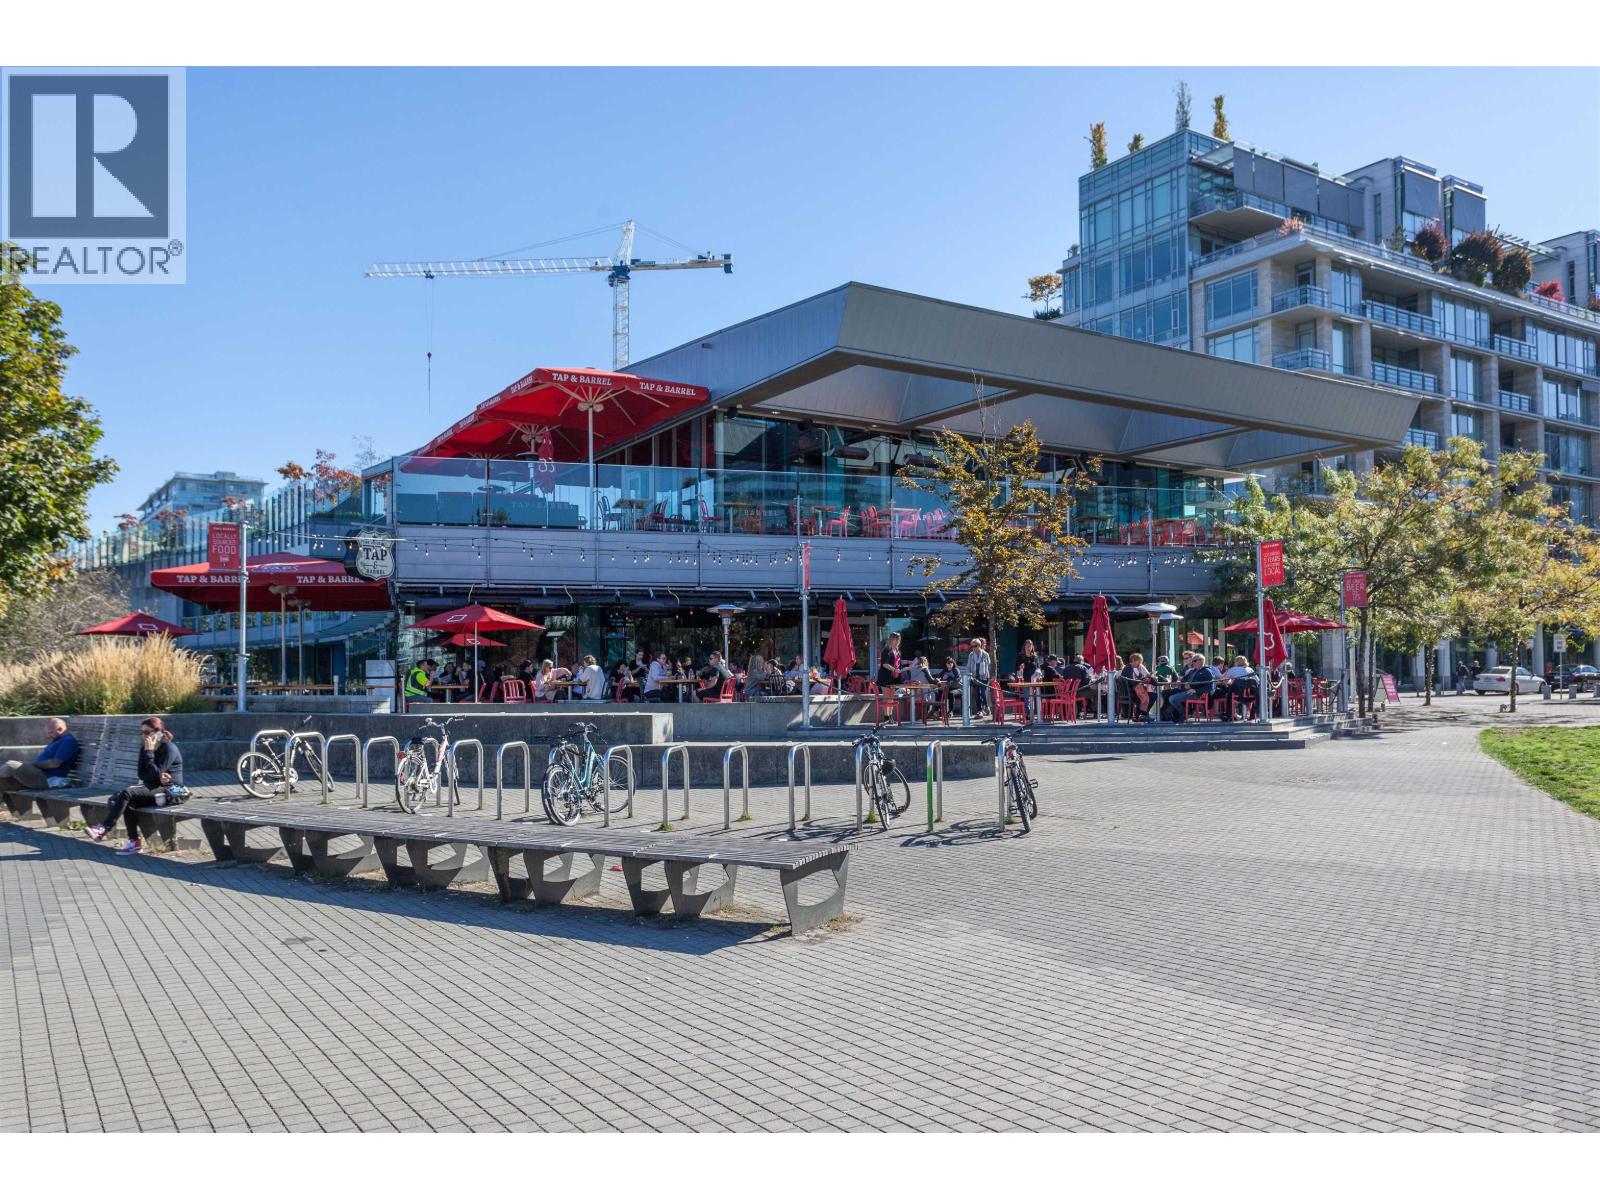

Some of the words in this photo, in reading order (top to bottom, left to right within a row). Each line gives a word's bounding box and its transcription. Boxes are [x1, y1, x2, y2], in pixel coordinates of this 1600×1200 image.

[552, 373, 569, 381] TAP
[571, 375, 577, 383] &
[579, 375, 612, 386] BARREL
[639, 382, 655, 391] TAP
[665, 386, 696, 396] BARREL
[212, 545, 237, 555] FOOD
[363, 547, 388, 560] TAP
[176, 575, 197, 583] TAP
[199, 575, 208, 583] &
[210, 575, 250, 584] BARR
[296, 575, 316, 584] TAP
[1346, 583, 1365, 592] BEER
